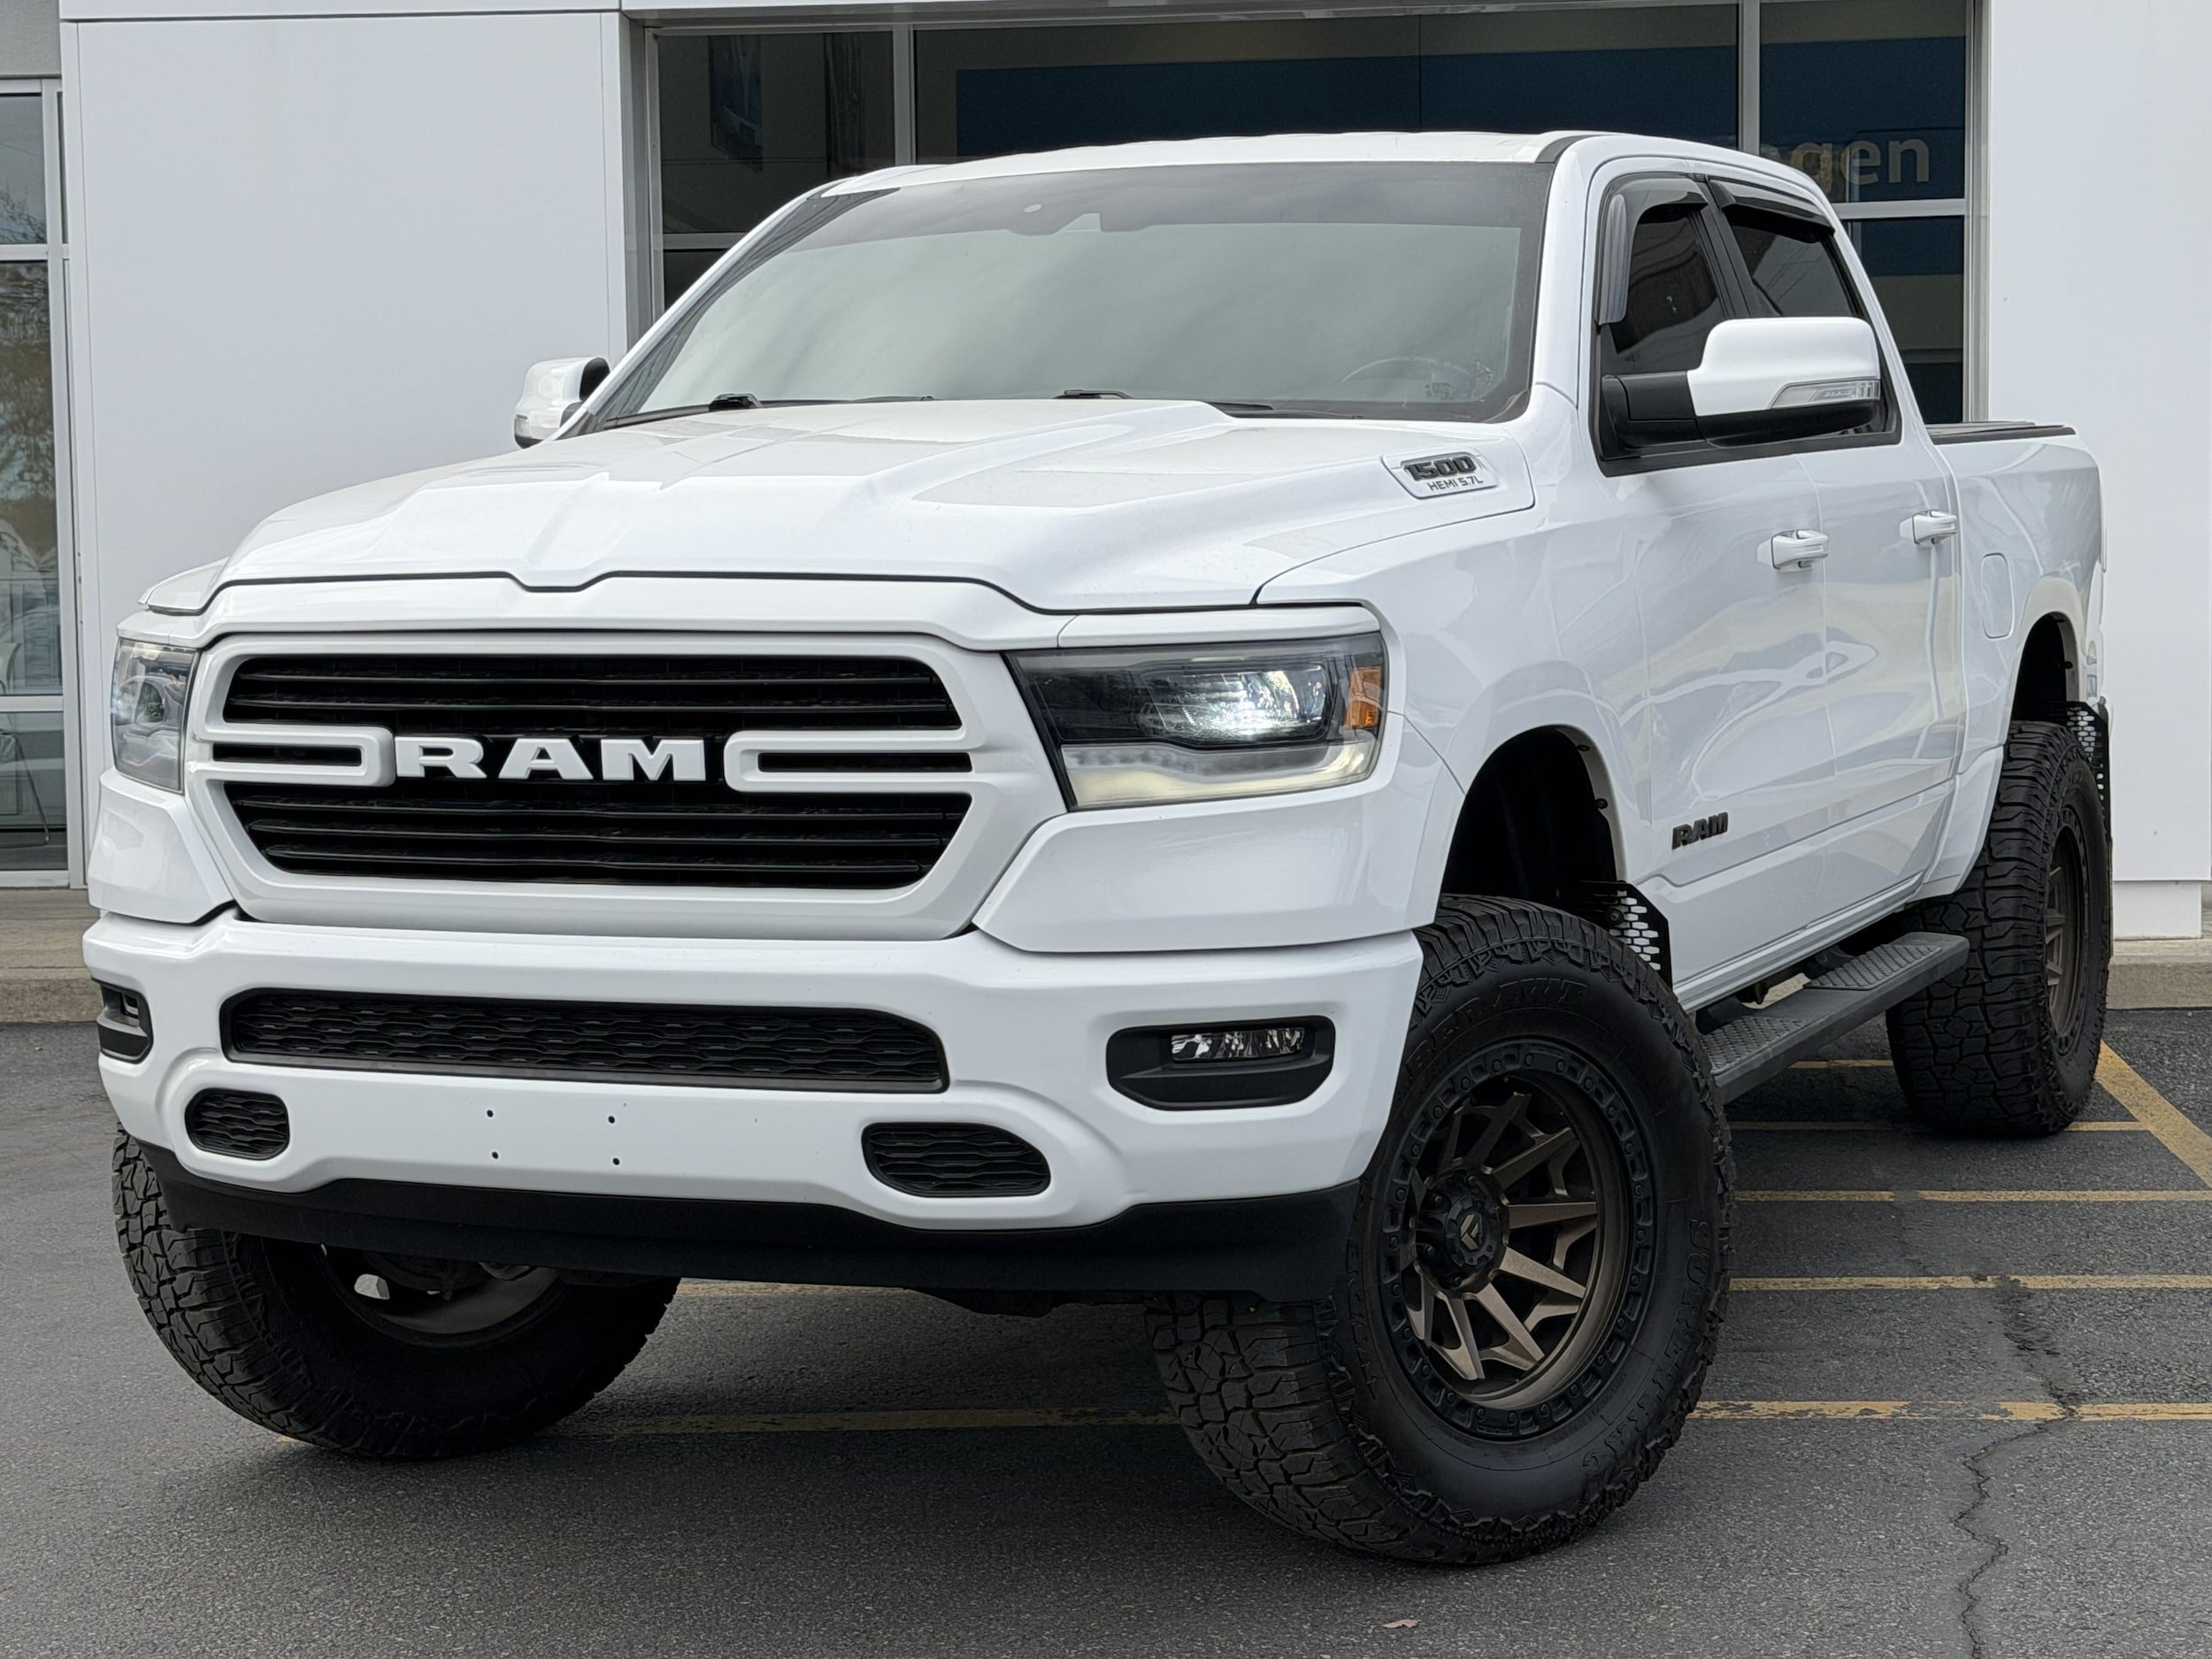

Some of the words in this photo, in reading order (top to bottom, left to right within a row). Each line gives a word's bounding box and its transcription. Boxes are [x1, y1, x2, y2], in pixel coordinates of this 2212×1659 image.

[1403, 456, 1477, 480] 1500
[1426, 478, 1459, 492] HEMI
[1460, 475, 1485, 488] 5.7L
[395, 735, 707, 782] RAM
[1671, 810, 1729, 851] RAM
